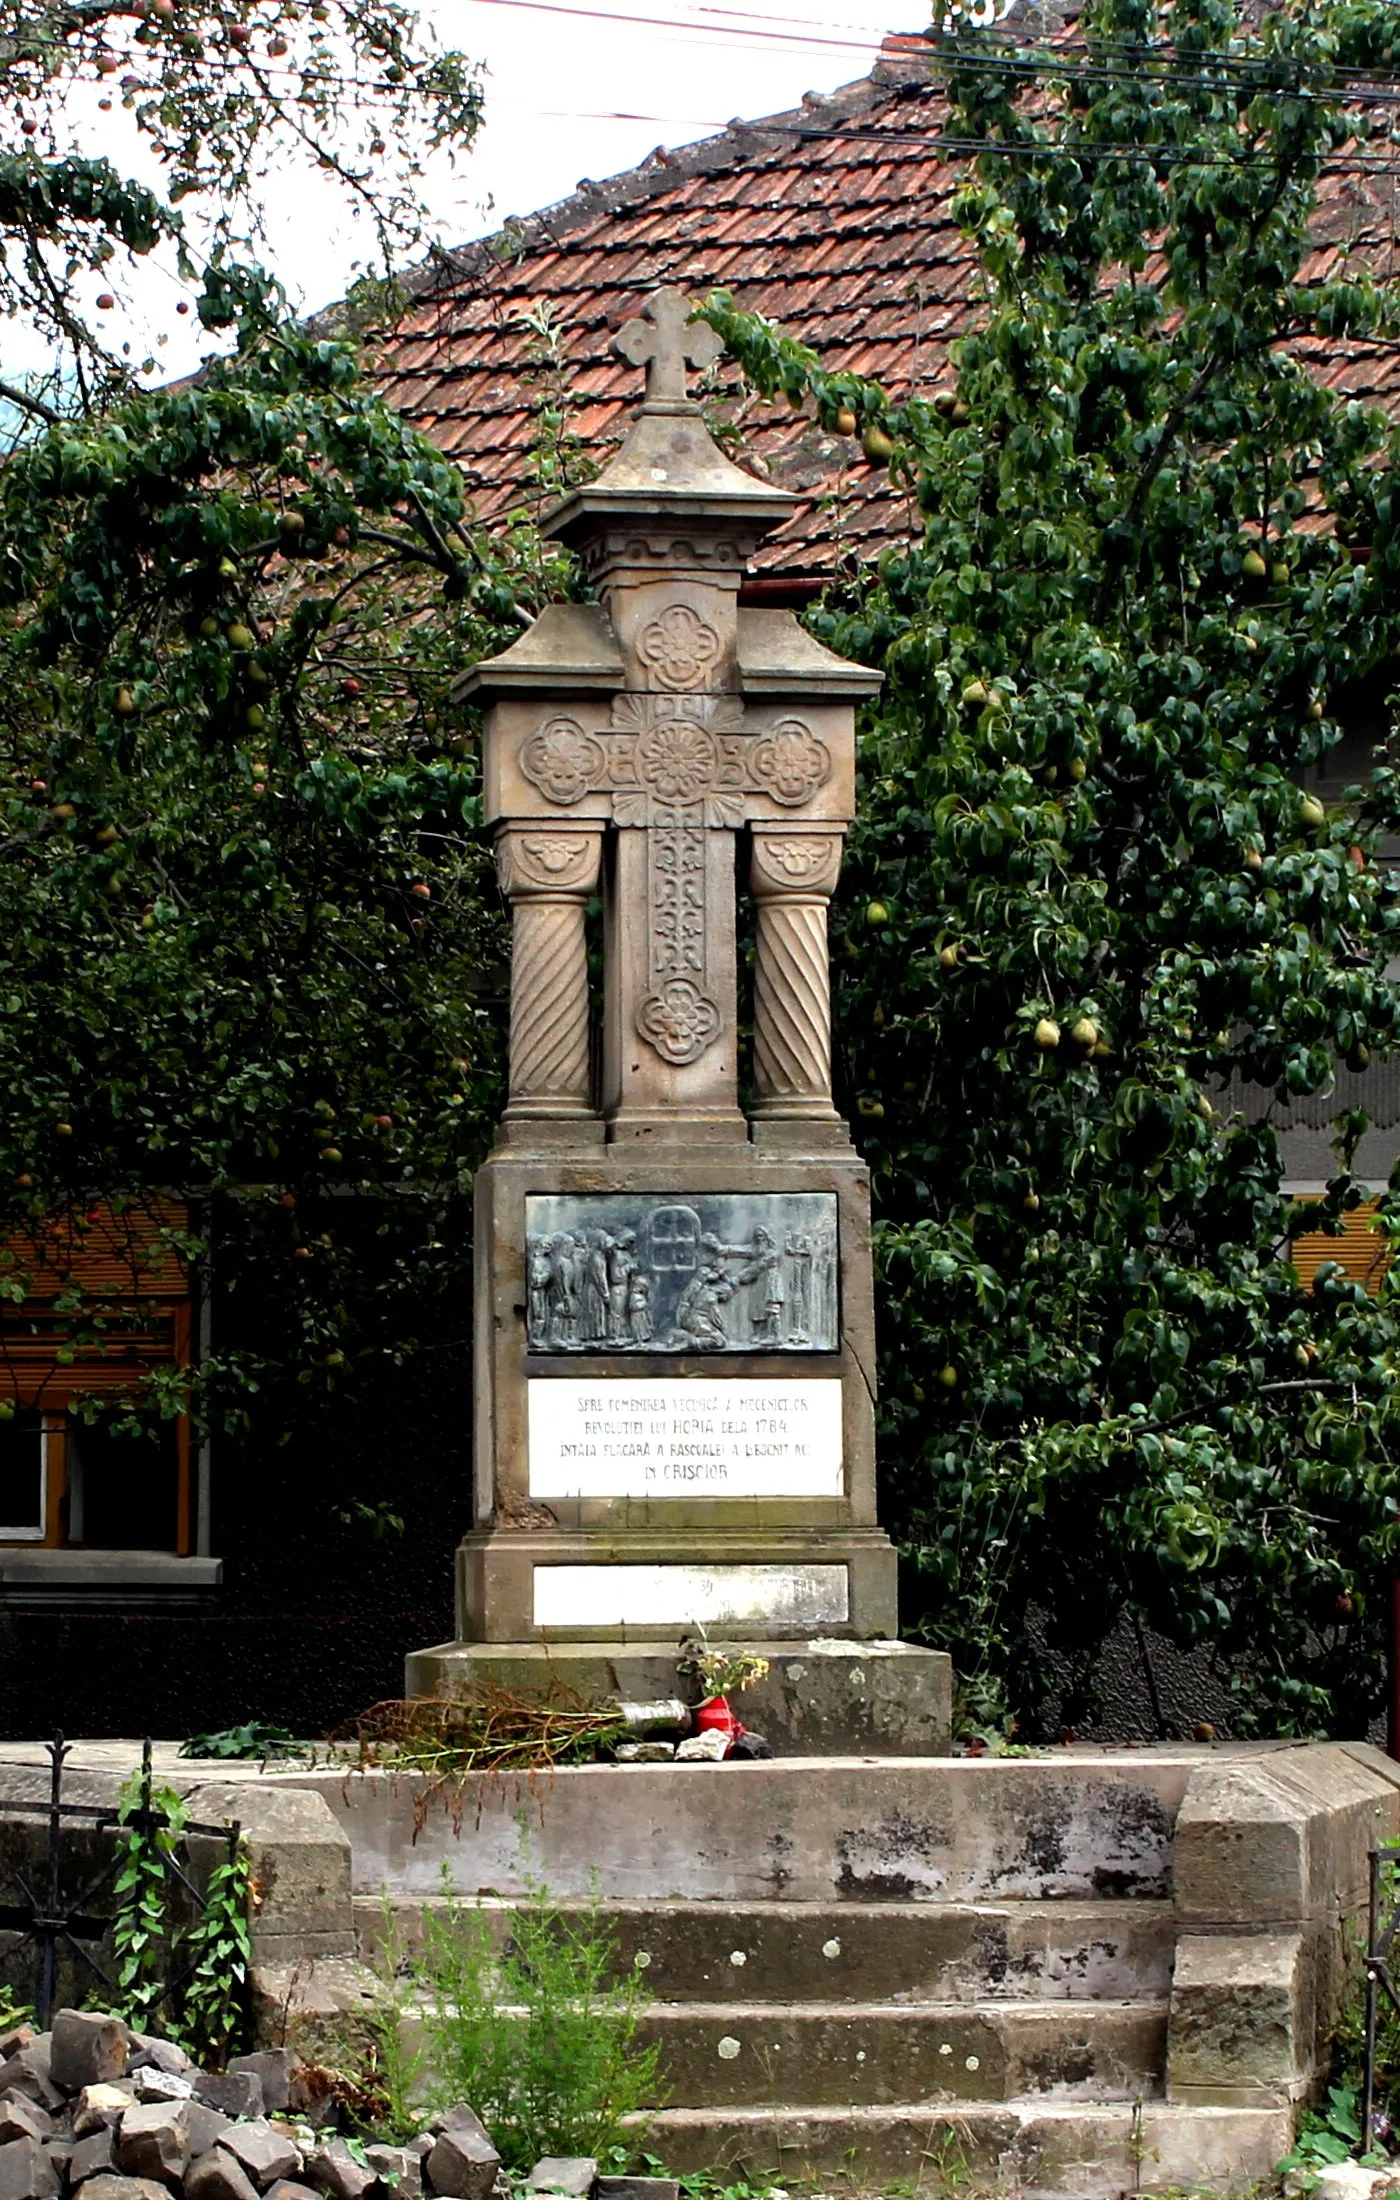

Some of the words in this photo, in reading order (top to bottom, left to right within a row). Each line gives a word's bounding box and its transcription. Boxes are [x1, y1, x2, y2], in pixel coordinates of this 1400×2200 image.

[577, 1397, 604, 1412] SPRE
[608, 1398, 666, 1412] POMENIREA
[650, 1421, 666, 1435] LUI
[673, 1418, 714, 1434] HORIA
[721, 1421, 747, 1434] DELA
[755, 1418, 787, 1433] 1784
[656, 1444, 665, 1457] A
[731, 1444, 739, 1457] A
